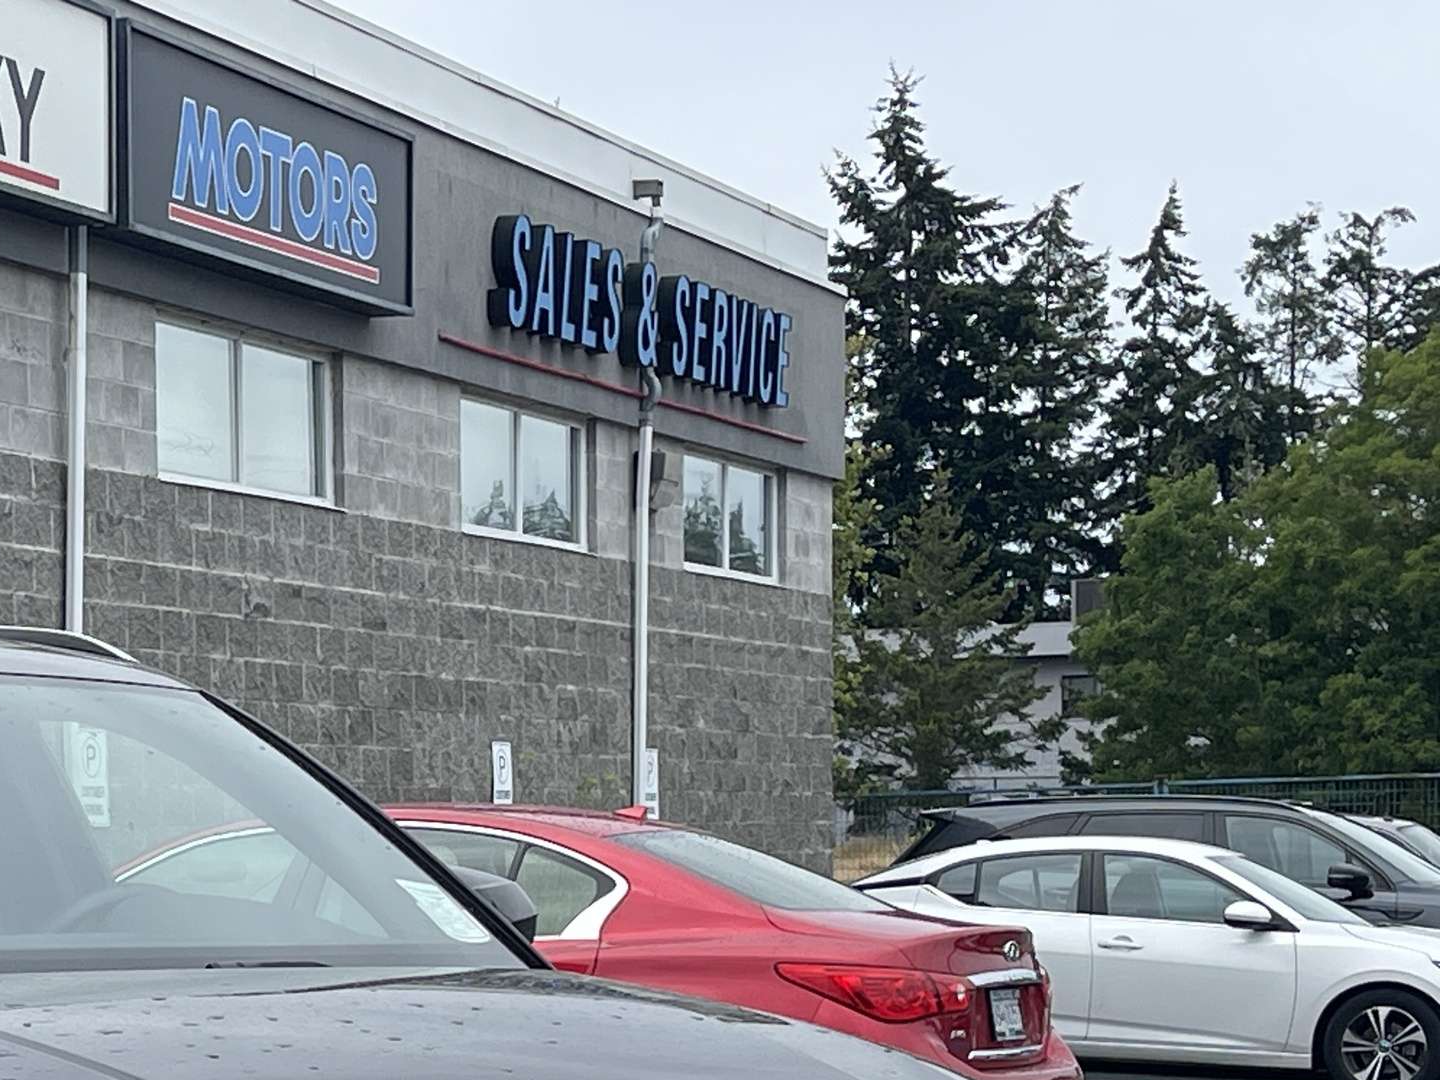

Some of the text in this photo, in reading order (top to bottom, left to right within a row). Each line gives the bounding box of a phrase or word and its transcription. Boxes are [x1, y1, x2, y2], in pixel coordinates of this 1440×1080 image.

[171, 96, 378, 261] MOTORS
[508, 213, 791, 408] SALES & SERVICE
